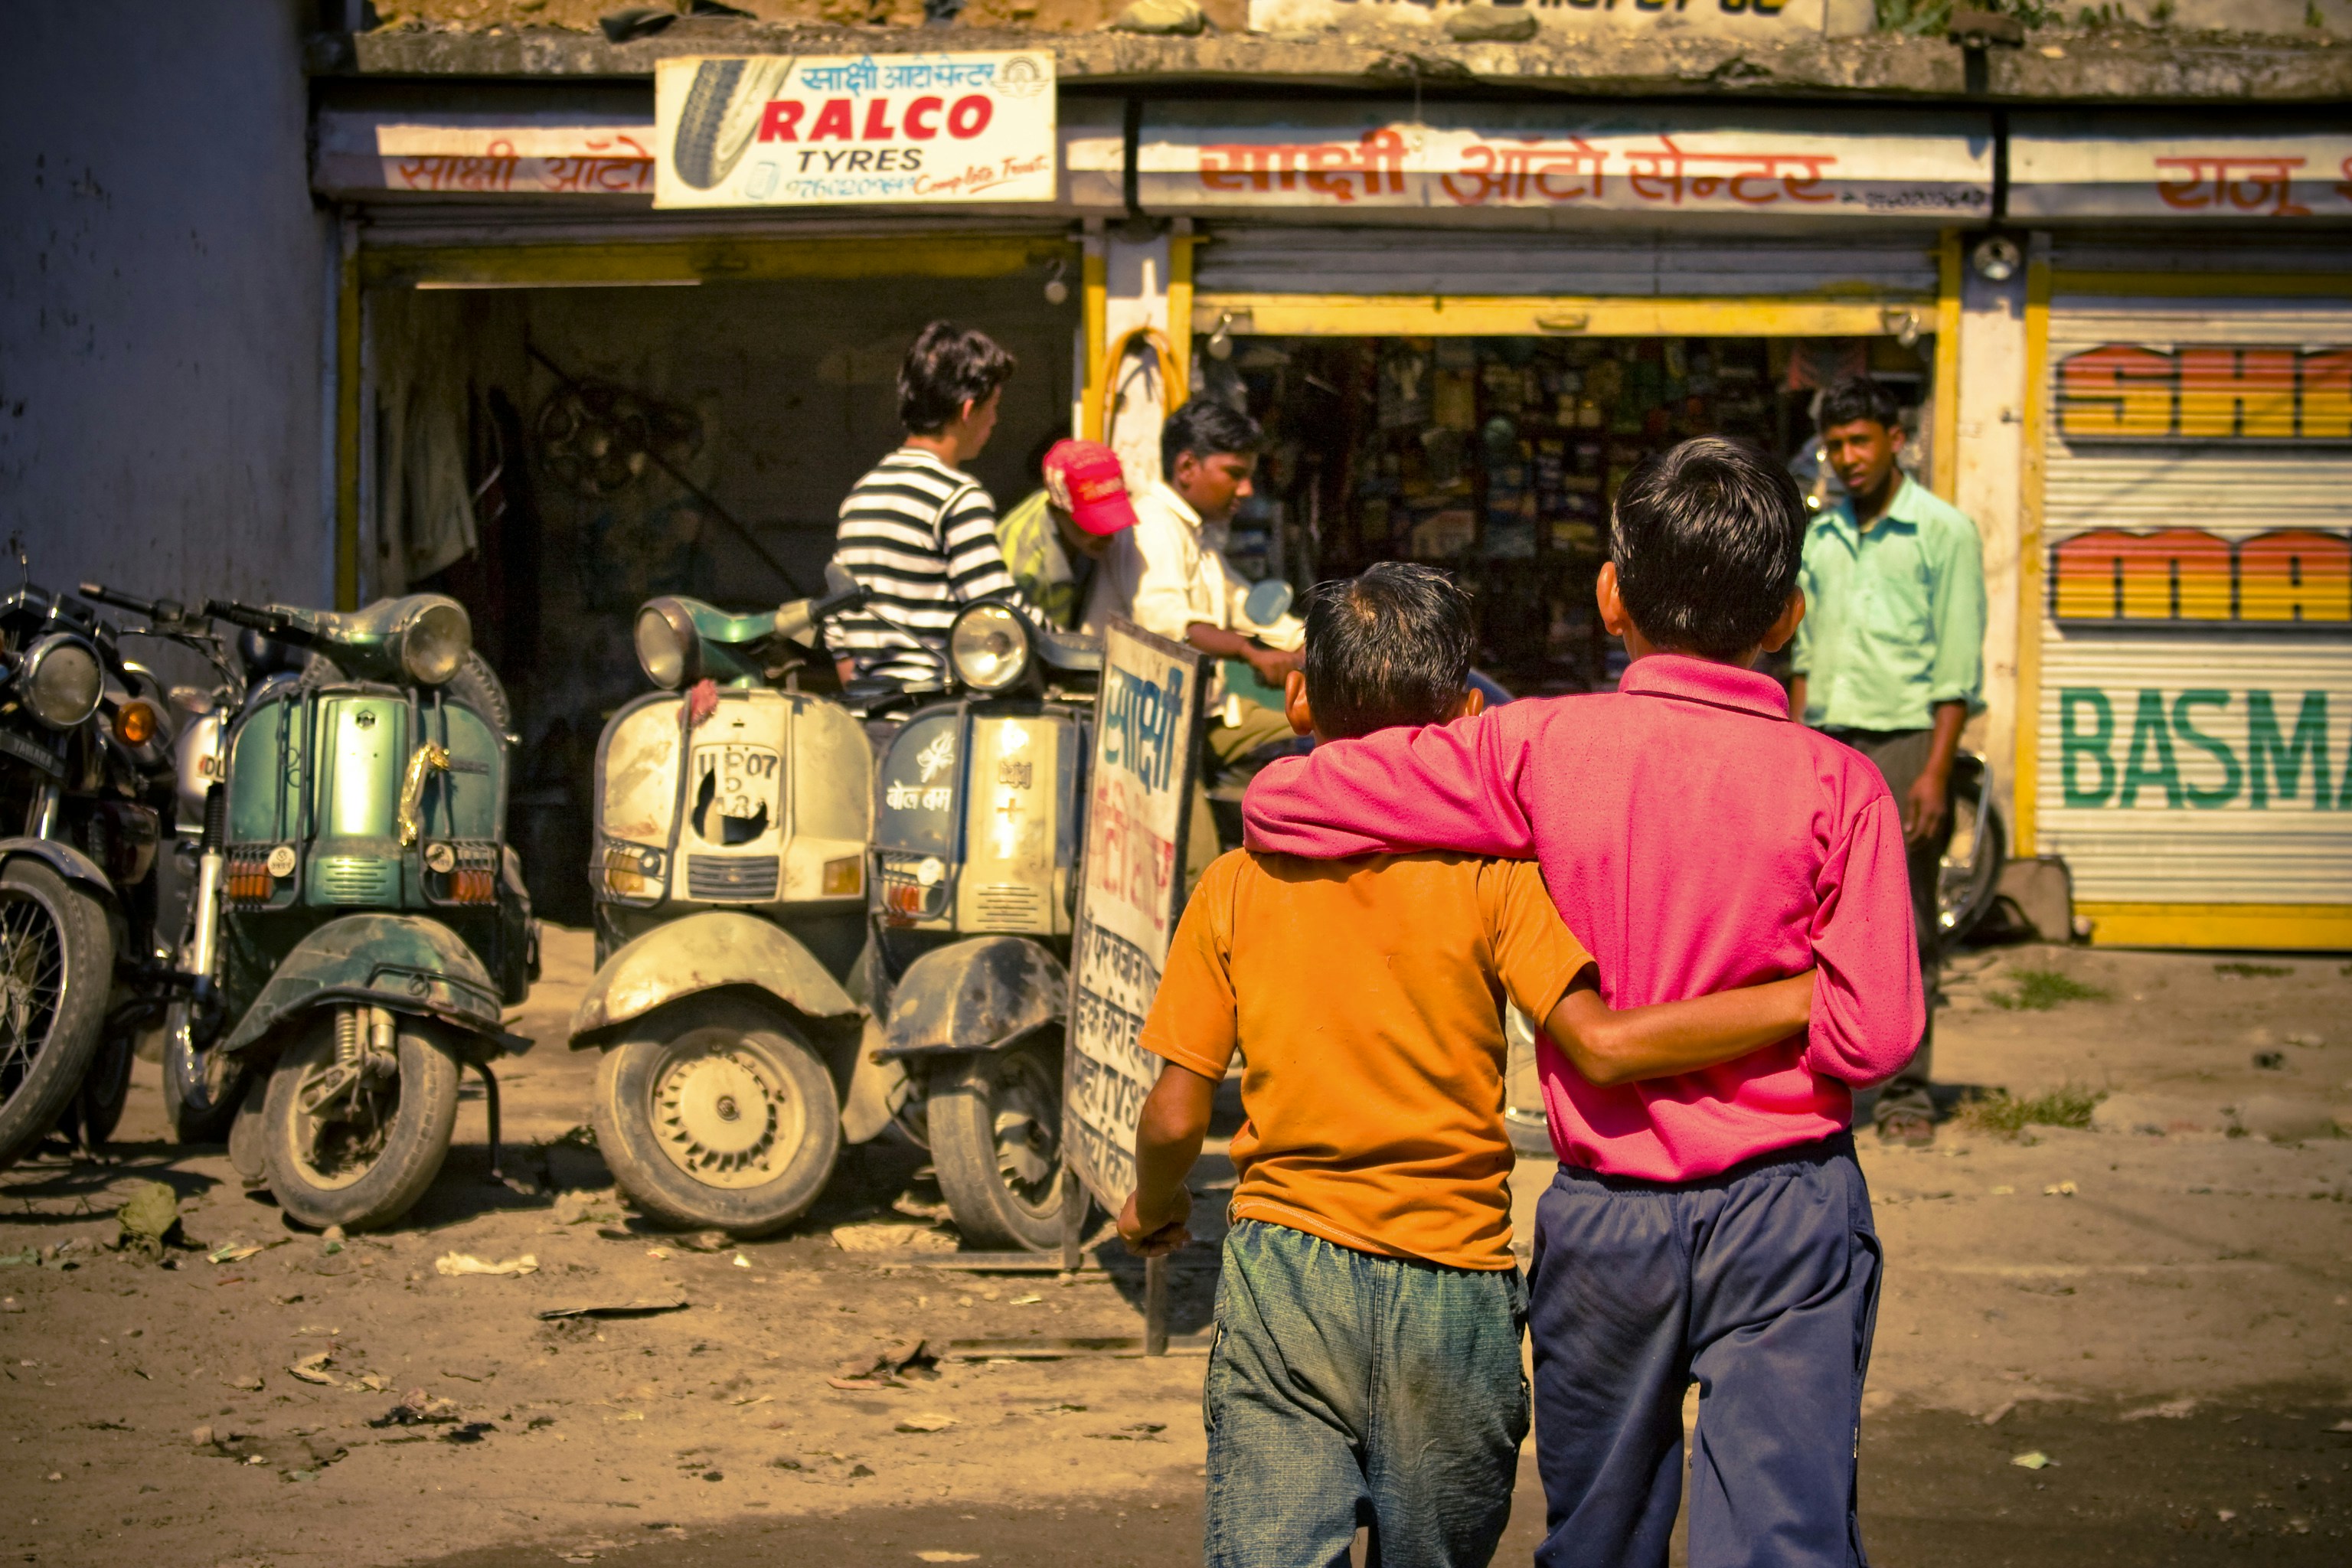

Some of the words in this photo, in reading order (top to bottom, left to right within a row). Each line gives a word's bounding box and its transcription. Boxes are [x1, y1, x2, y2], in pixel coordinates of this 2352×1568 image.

[758, 94, 993, 143] RALCO
[399, 139, 521, 191] साक्षी
[797, 149, 923, 173] TYRES
[14, 737, 54, 769] YAMAHA
[2060, 687, 2352, 810] BASM
[886, 779, 922, 811] बोल
[922, 786, 953, 812] बम
[1102, 1063, 1139, 1133] TVS
